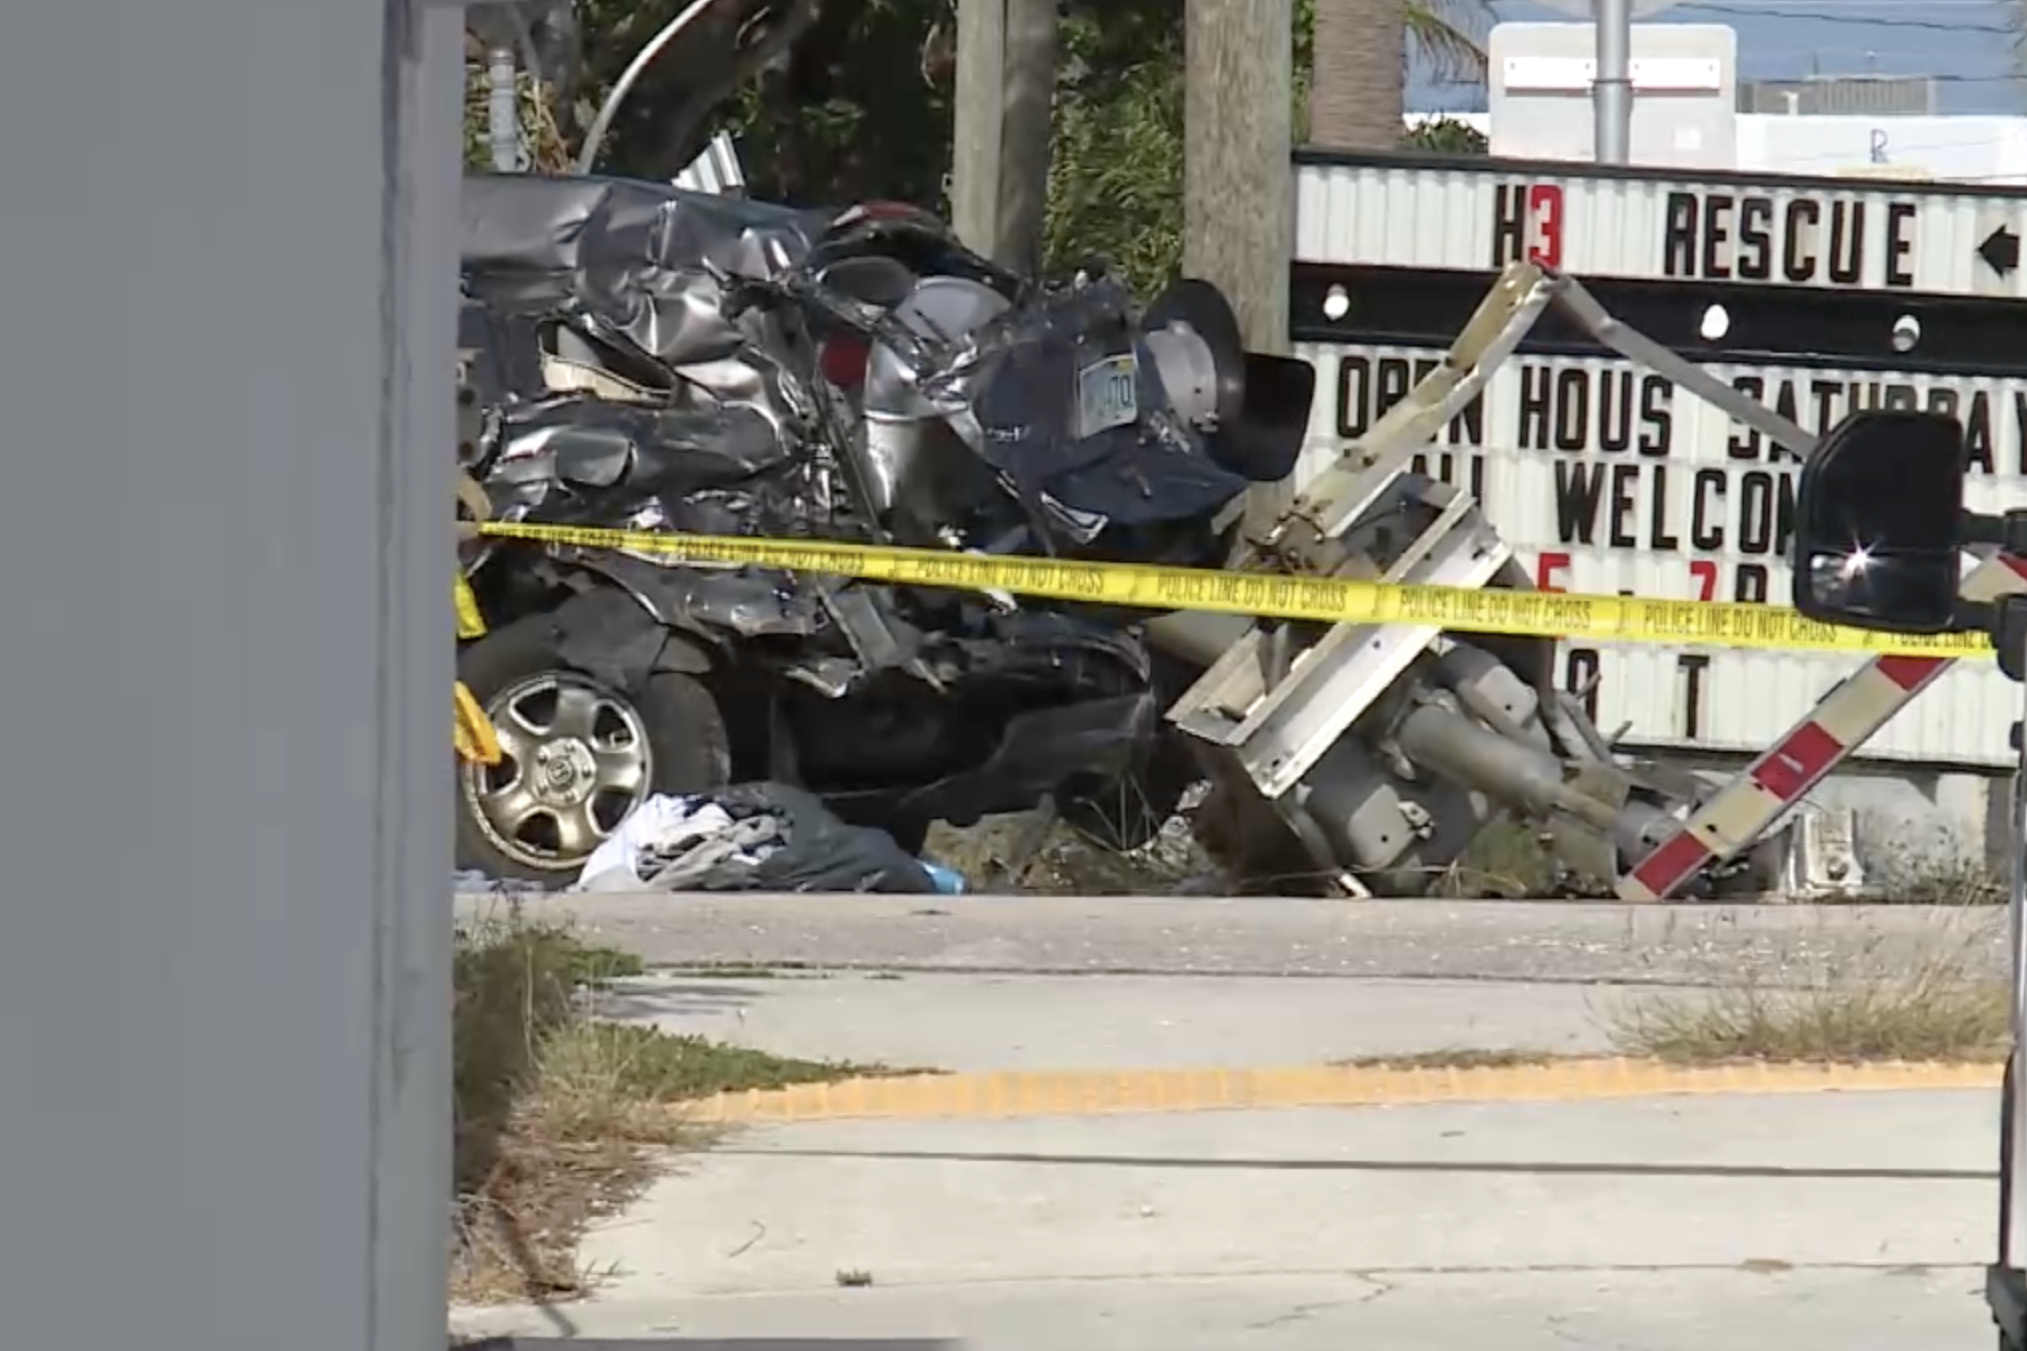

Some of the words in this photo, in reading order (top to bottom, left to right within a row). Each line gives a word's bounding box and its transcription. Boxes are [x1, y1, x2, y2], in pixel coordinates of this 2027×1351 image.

[1494, 184, 1563, 268] H3
[1664, 191, 1916, 287] RESCUE
[1518, 365, 1673, 457] HOUS
[1158, 572, 1205, 600] POLICE
[1301, 583, 1348, 612] CROSS
[1400, 588, 1448, 618] POLICE
[1452, 590, 1484, 622] LINE
[1488, 593, 1510, 623] DO
[1511, 595, 1542, 627] NOT
[1543, 597, 1592, 630] CROSS
[1645, 604, 1694, 634] POLICE
[1698, 606, 1730, 636] LINE
[1734, 609, 1753, 638] DO
[1757, 610, 1787, 640] NOT
[1678, 654, 1710, 738] T
